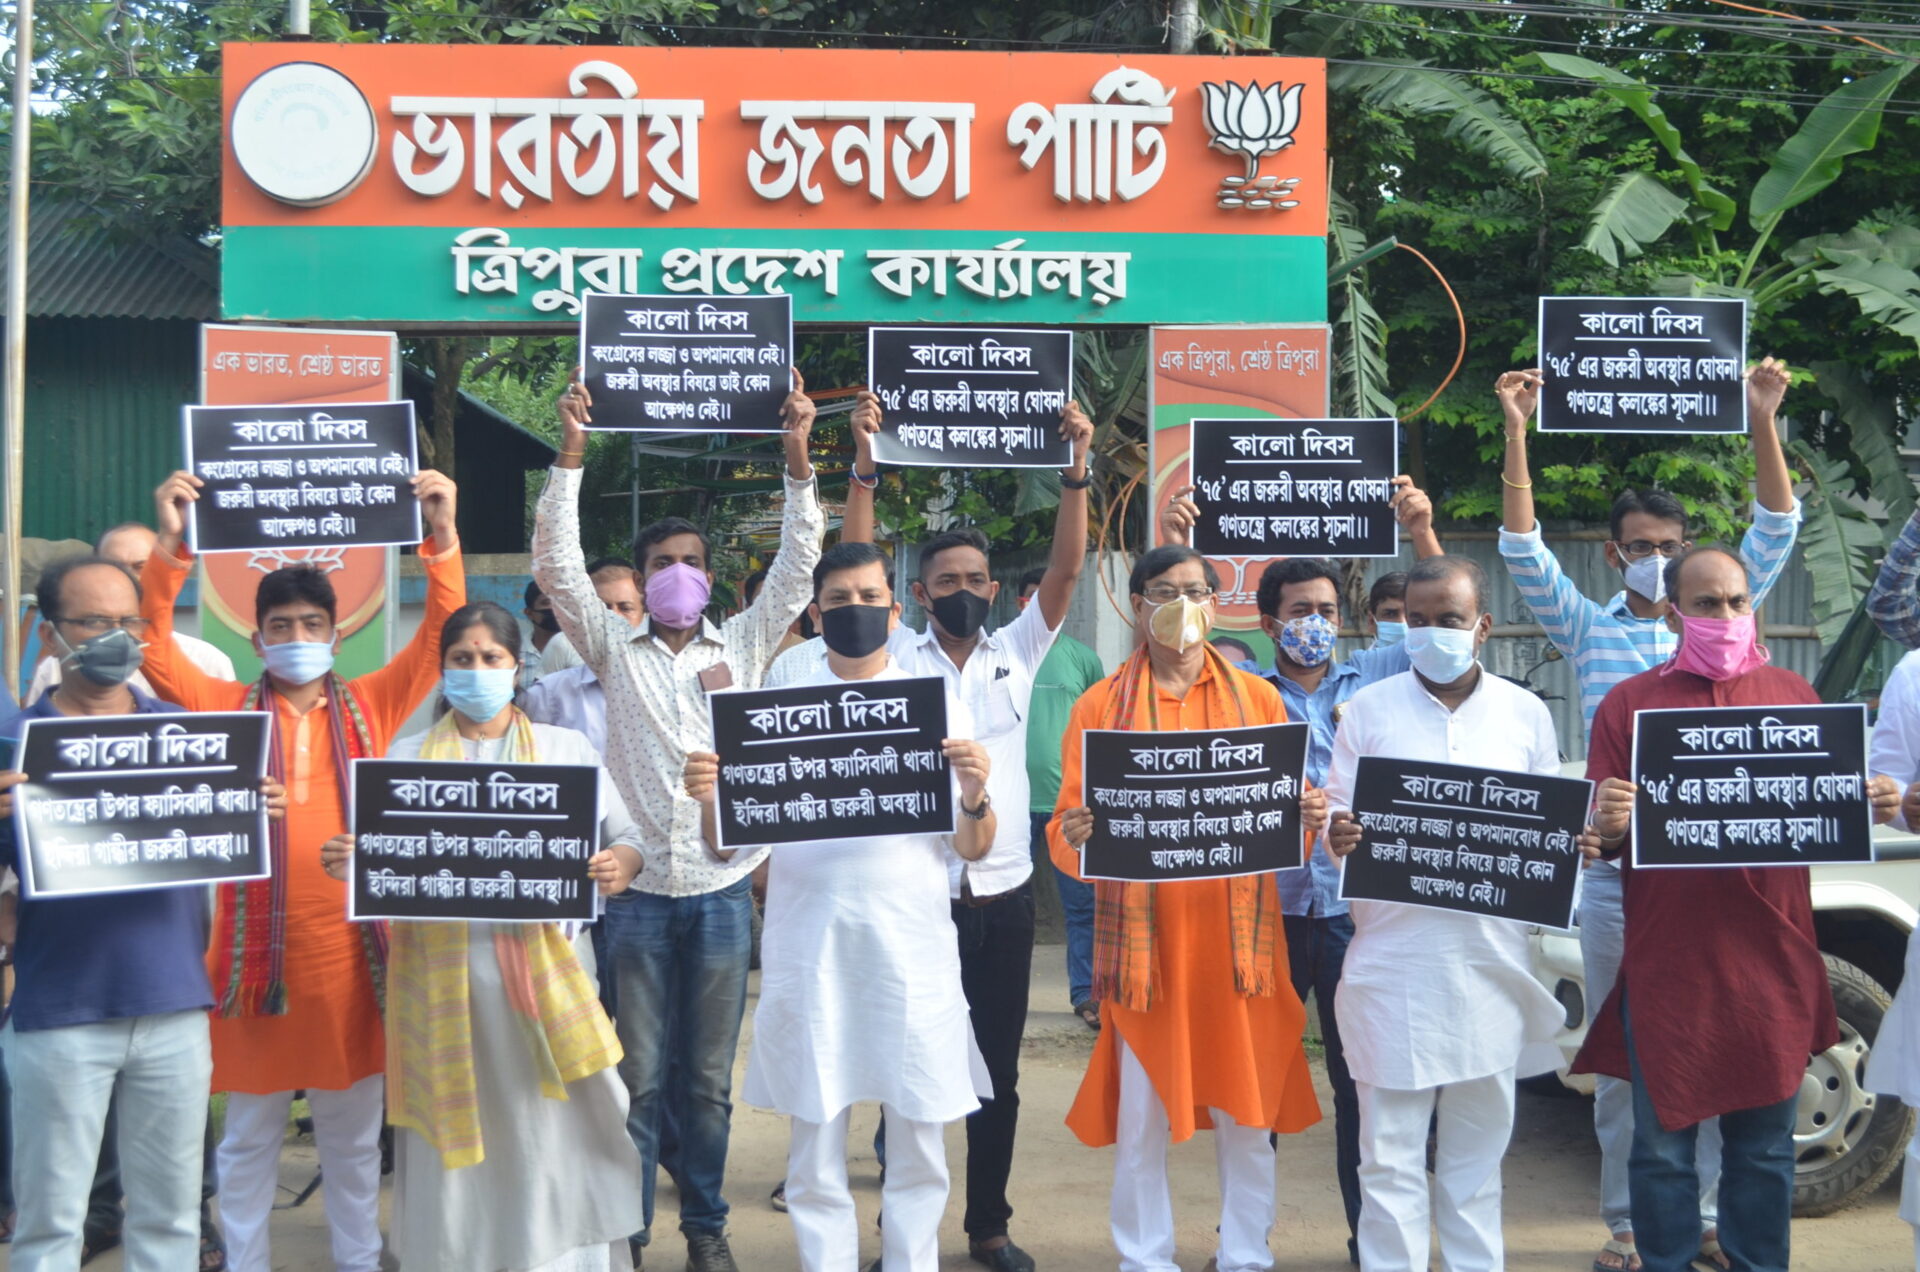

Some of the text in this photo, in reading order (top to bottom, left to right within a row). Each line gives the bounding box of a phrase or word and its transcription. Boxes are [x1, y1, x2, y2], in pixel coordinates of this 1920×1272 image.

[391, 60, 1177, 211] ভারতীয় জনতা পার্টি
[451, 228, 642, 315] ত্রিপুরা
[661, 247, 844, 296] প্রদেশ
[624, 303, 749, 331] কালো দিবস
[1579, 306, 1703, 334] কালো দিবস
[213, 345, 383, 377] এক ভারত, শ্রেষ্ঠ ভারত
[591, 344, 645, 362] কংগ্রেসের
[646, 346, 676, 365] লজ্জা
[678, 348, 689, 363] ও
[690, 345, 755, 364] অপমানবোধ
[909, 338, 1031, 366] কালো দিবস
[1159, 341, 1319, 377] এক ত্রিপুরা, শ্রেষ্ঠ ত্রিপুরা
[1577, 356, 1599, 378] এর
[1600, 348, 1641, 379] জরুরী
[1643, 355, 1691, 386] অবস্থার
[1695, 356, 1738, 381] ঘোষনা
[604, 366, 770, 396] জরুরী অবস্থার বিষয়ে তাই কোন
[643, 400, 694, 419] আক্ষেপও
[908, 389, 929, 411] এর
[931, 380, 971, 413] জরুরী
[973, 387, 1019, 419] অবস্থার
[1566, 389, 1614, 417] গণতন্ত্রে
[1615, 392, 1668, 415] কলঙ্কের
[232, 411, 368, 442] কালো দিবস
[897, 422, 944, 451] গণতন্ত্রে
[946, 425, 997, 449] কলঙ্কের
[1229, 427, 1354, 456] কালো দিবস
[199, 459, 258, 479] কংগ্রেসের
[259, 458, 293, 478] লজ্জা
[294, 459, 306, 475] ও
[306, 456, 377, 475] অপমানবোধ
[216, 480, 395, 512] জরুরী অবস্থার বিষয়ে তাই কোন
[1228, 480, 1250, 502] এর
[1252, 470, 1293, 502] জরুরী
[1294, 477, 1342, 508] অবস্থার
[1348, 477, 1390, 503] ঘোষনা
[260, 516, 317, 537] আক্ষেপও
[1218, 513, 1266, 542] গণতন্ত্রে
[1267, 516, 1319, 539] কলঙ্কের
[744, 690, 908, 734] কালো দিবস
[1677, 716, 1819, 750] কালো দিবস
[722, 762, 786, 786] গণতন্ত্রের
[788, 754, 826, 779] উপর
[828, 745, 898, 778] ফ্যাসিবাদী
[1129, 737, 1264, 770] কালো দিবস
[389, 771, 559, 811] কালো দিবস
[1092, 786, 1152, 808] কংগ্রেসের
[1154, 787, 1186, 808] লজ্জা
[1189, 788, 1199, 805] ও
[1202, 781, 1269, 804] অপমানবোধ
[1400, 774, 1540, 811] কালো দিবস
[1677, 778, 1701, 804] এর
[1703, 766, 1750, 804] জরুরী
[1752, 773, 1807, 809] অবস্থার
[1813, 771, 1861, 801] ঘোষনা
[731, 797, 779, 826] ইন্দিরা
[783, 792, 827, 821] গান্ধীর
[829, 787, 875, 817] জরুরী
[1108, 809, 1282, 842] জরুরী অবস্থার বিষয়ে তাই কোন
[1359, 810, 1417, 833] কংগ্রেসের
[1420, 817, 1453, 838] লজ্জা
[1455, 821, 1466, 838] ও
[1469, 822, 1541, 848] অপমানবোধ
[1665, 817, 1720, 849] গণতন্ত্রে
[1722, 818, 1781, 844] কলঙ্কের
[359, 832, 427, 858] গণতন্ত্রের
[429, 828, 469, 855] উপর
[471, 829, 544, 859] ফ্যাসিবাদী
[1150, 847, 1204, 868] আক্ষেপও
[1370, 837, 1555, 881] জরুরী অবস্থার বিষয়ে তাই কোন
[367, 867, 416, 897] ইন্দিরা
[419, 868, 466, 898] গান্ধীর
[469, 870, 516, 898] জরুরী
[1410, 875, 1465, 898] আক্ষেপও
